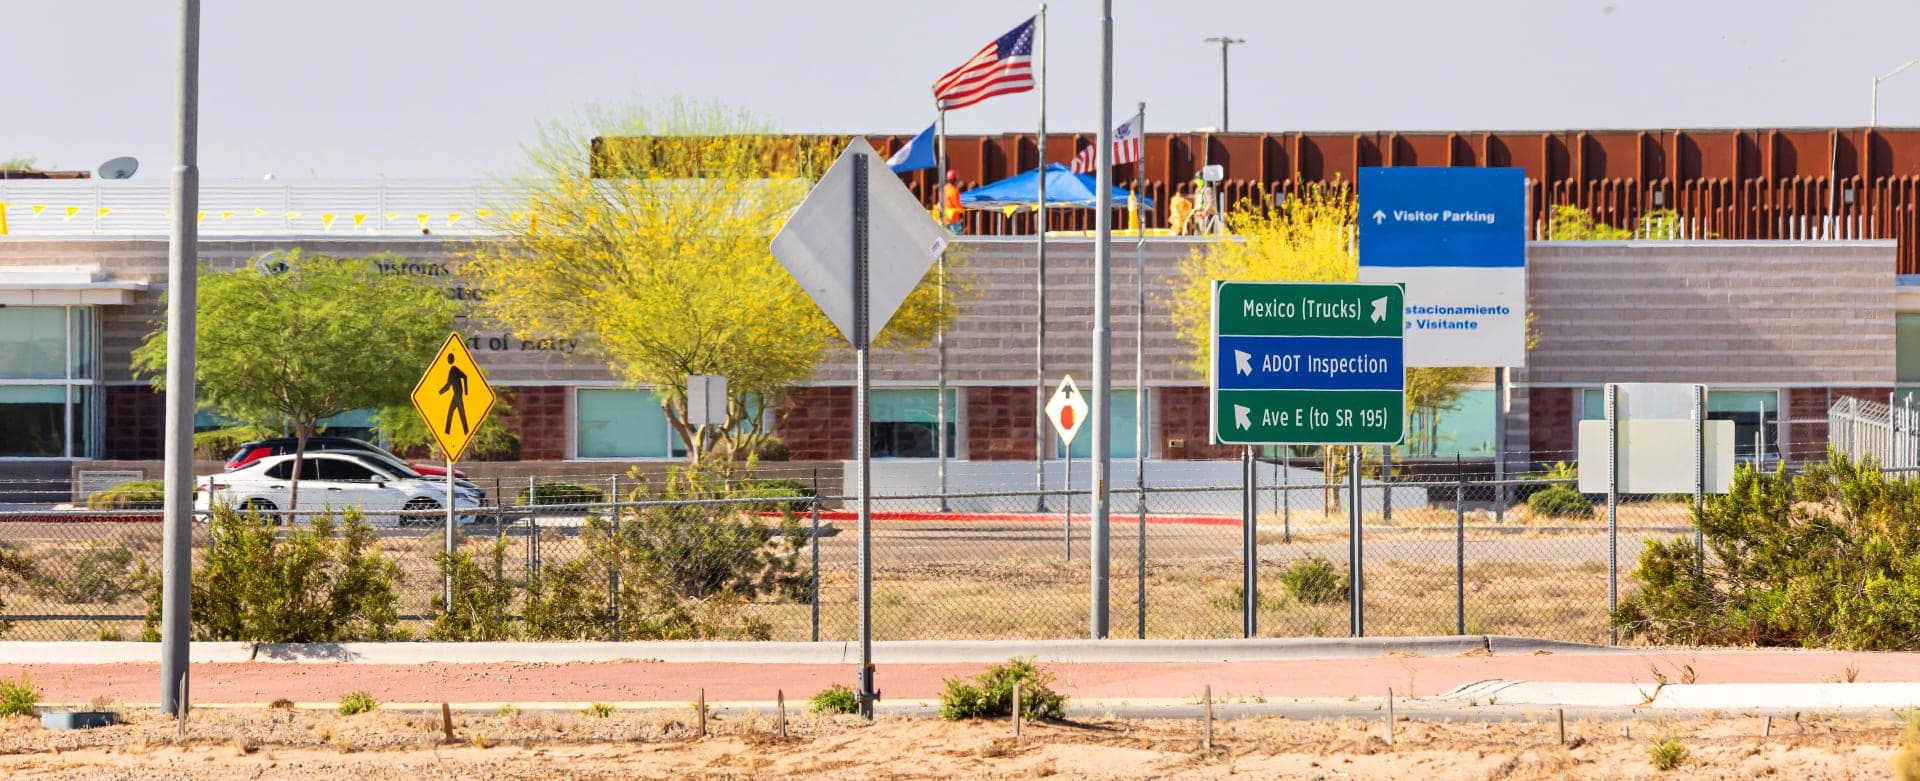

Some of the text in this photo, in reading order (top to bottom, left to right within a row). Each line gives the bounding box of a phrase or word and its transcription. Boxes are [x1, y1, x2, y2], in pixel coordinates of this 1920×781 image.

[1393, 210, 1495, 224] Visitor Parking
[1243, 297, 1361, 321] Mexico (Trucks)
[1405, 305, 1510, 315] stacionamiento
[1416, 319, 1478, 329] Visitante
[489, 333, 511, 351] of
[1262, 354, 1388, 378] ADOT Inspection
[1262, 406, 1388, 430] Ave E (to SR 195)
